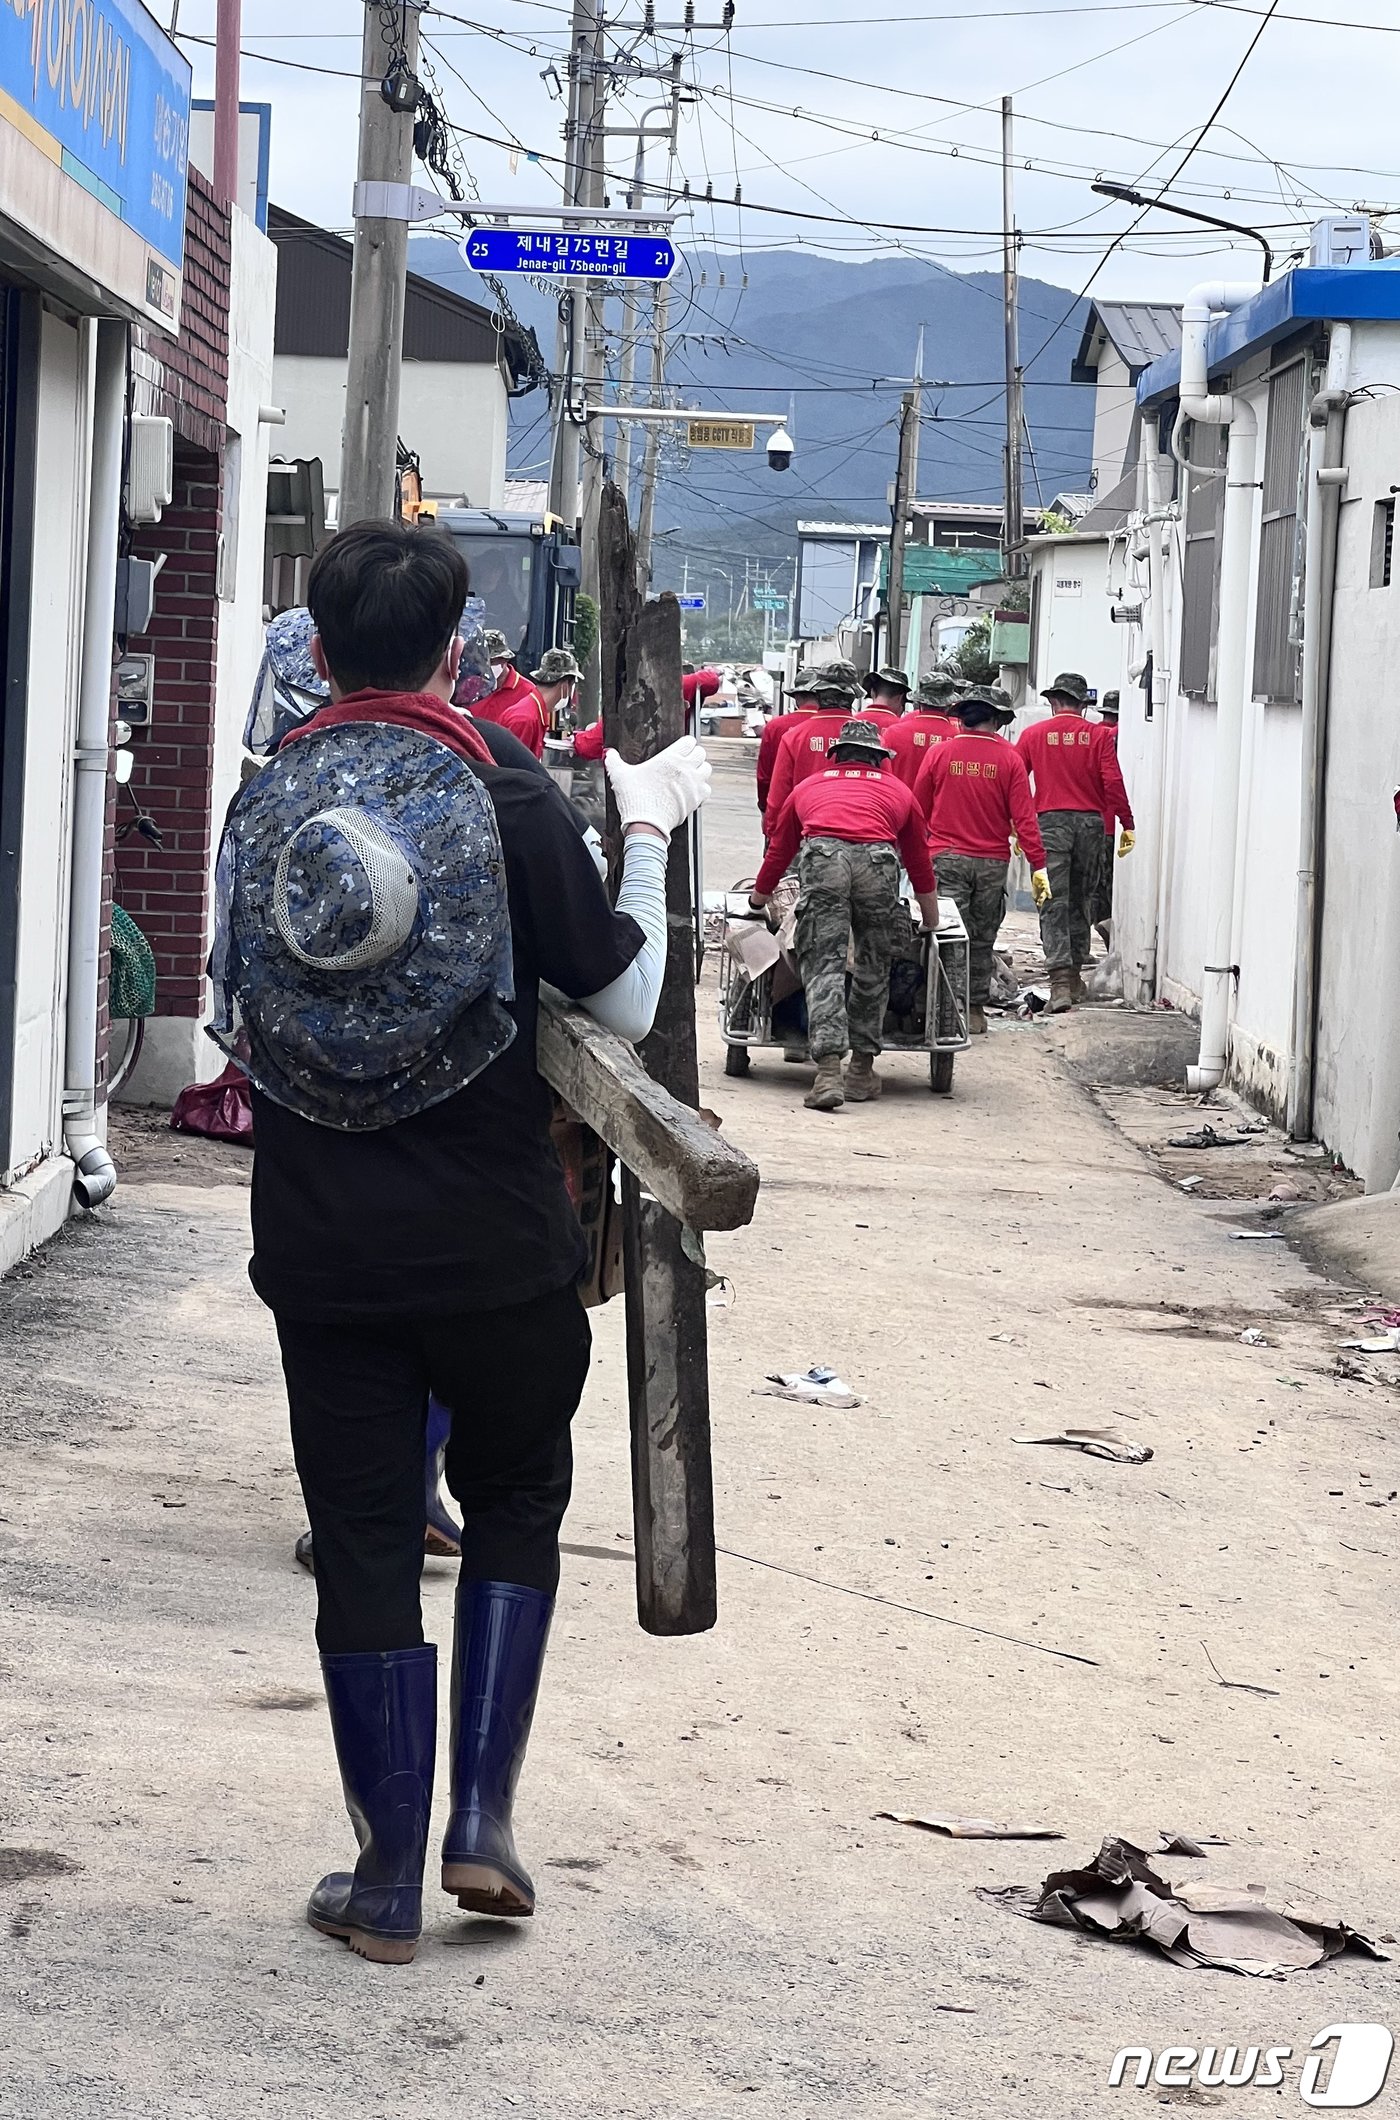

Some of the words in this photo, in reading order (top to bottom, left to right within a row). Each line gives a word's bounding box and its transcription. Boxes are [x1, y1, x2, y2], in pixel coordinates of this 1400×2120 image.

[472, 243, 489, 257] 25
[516, 256, 566, 272] Jenae-gil
[570, 259, 627, 274] 75beon-gil
[655, 251, 670, 265] 21
[712, 427, 730, 442] CCTV
[950, 760, 997, 779] 해병대
